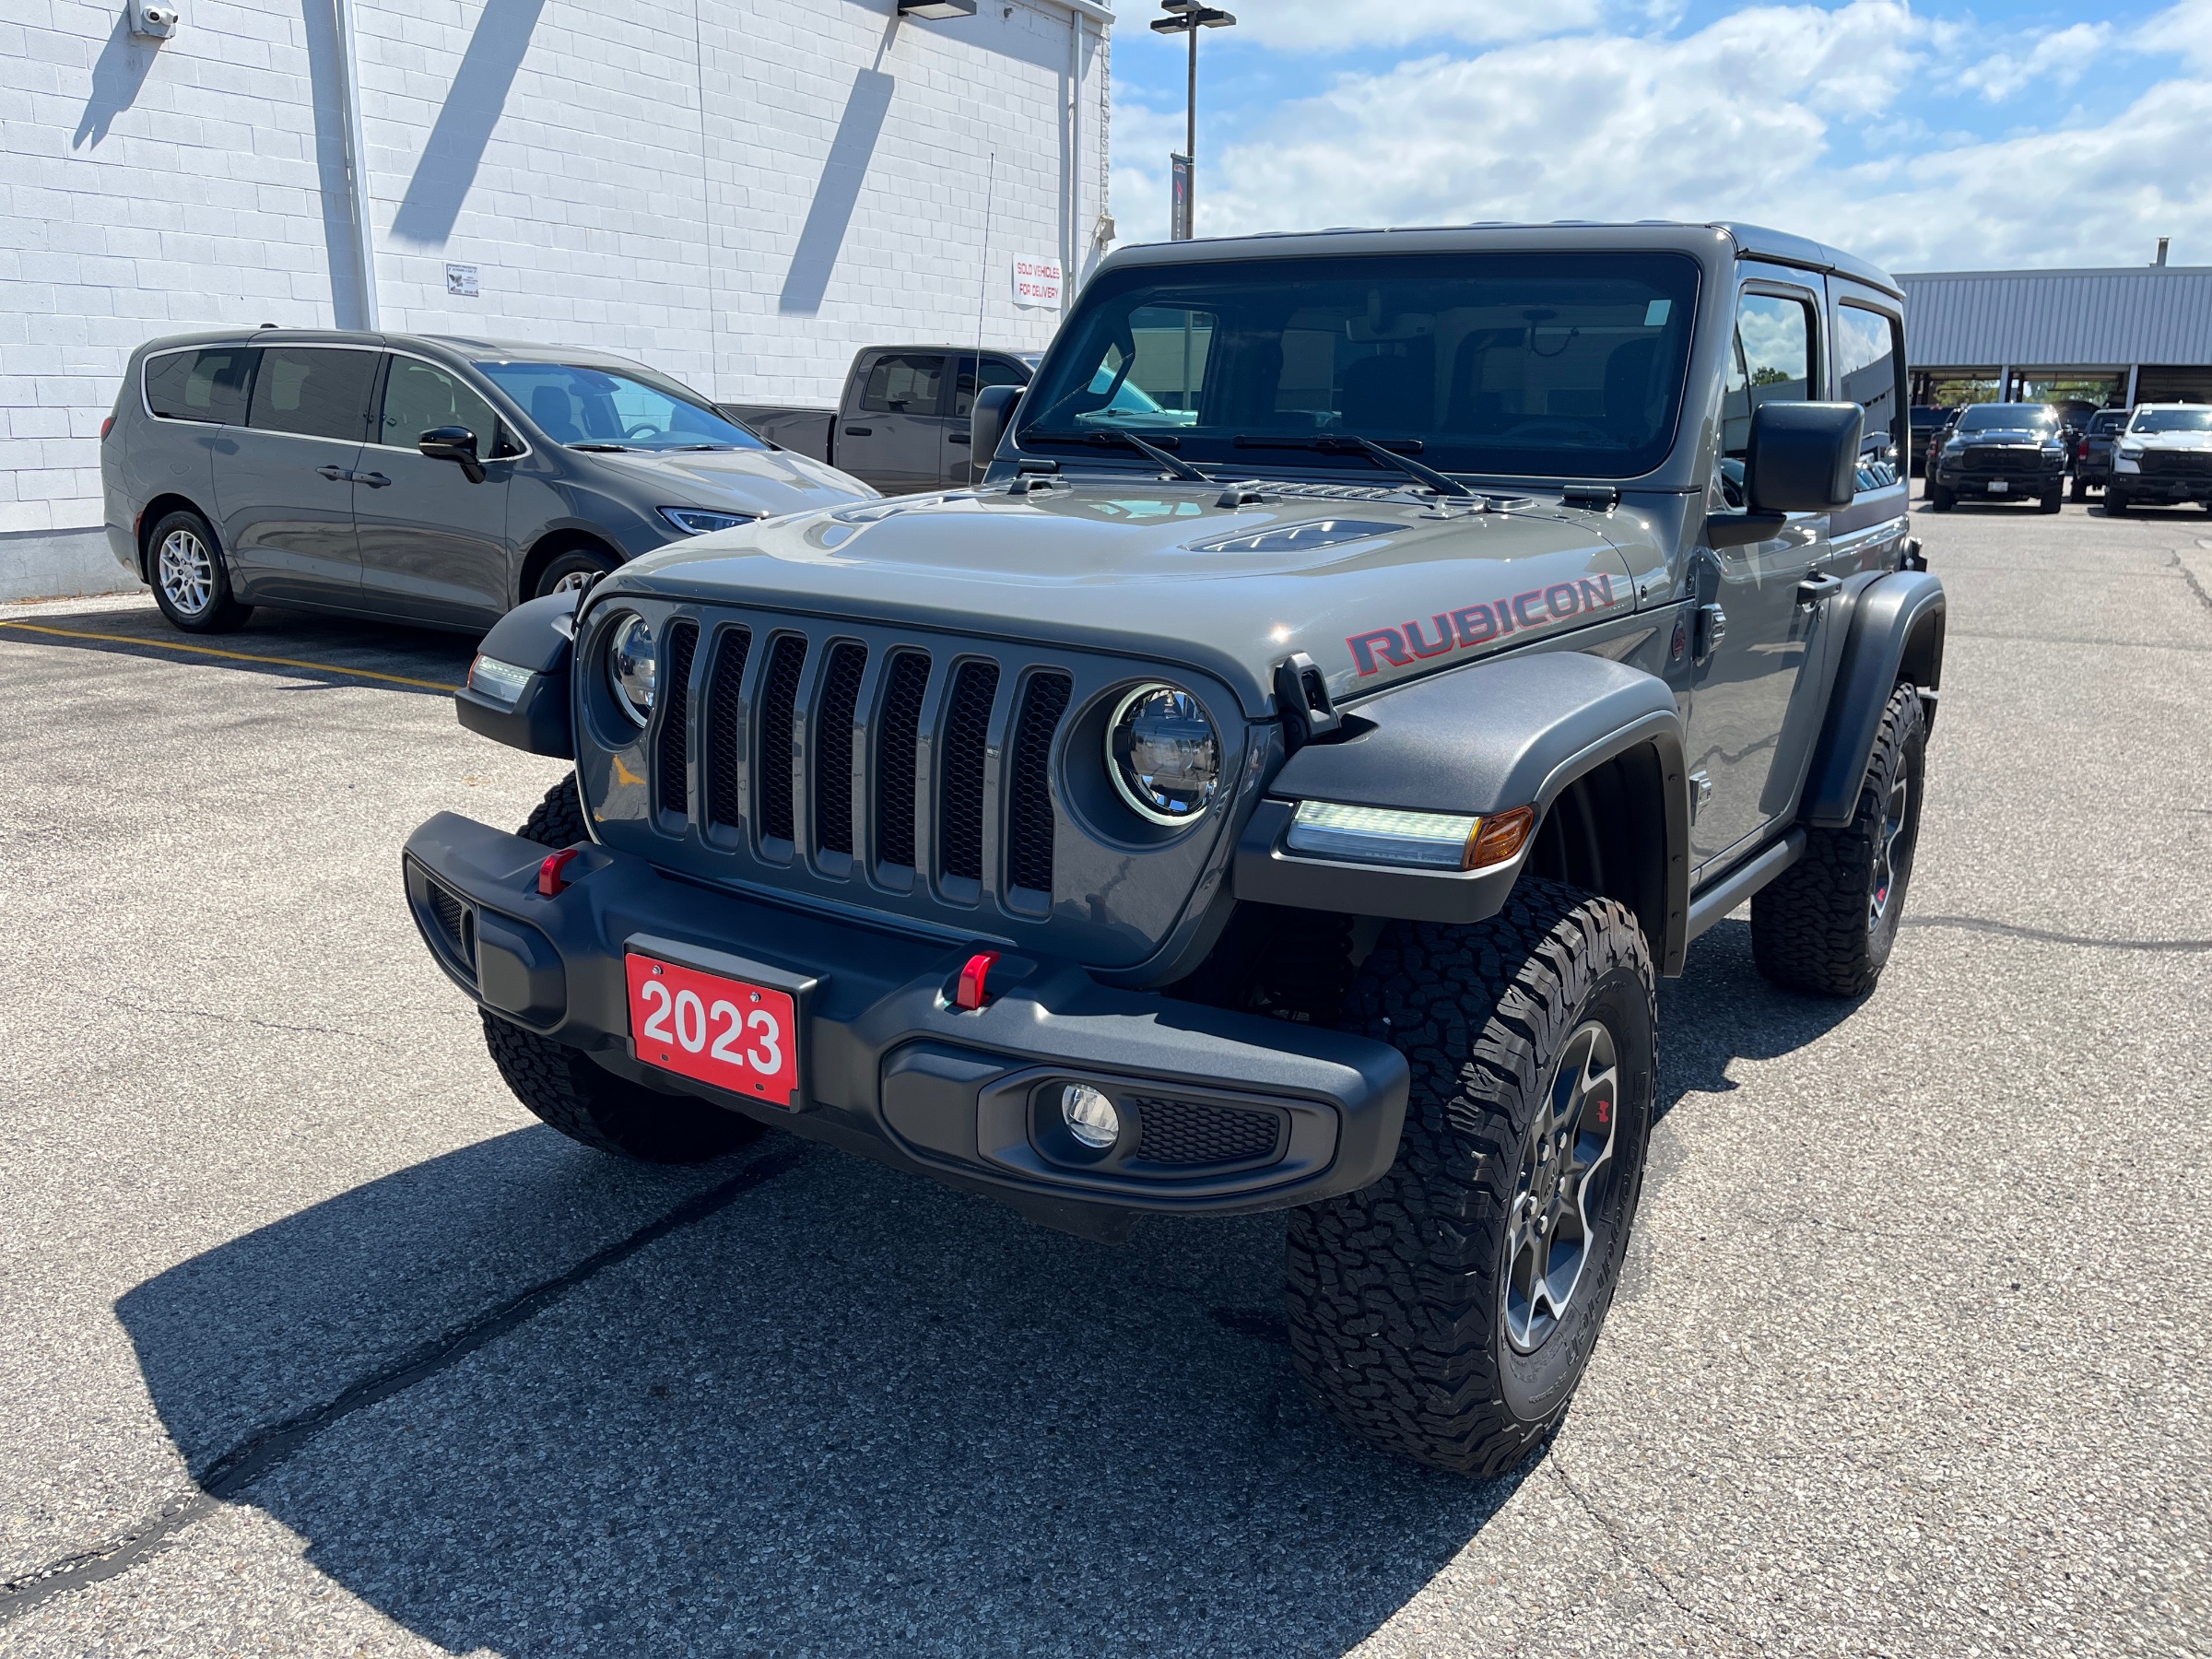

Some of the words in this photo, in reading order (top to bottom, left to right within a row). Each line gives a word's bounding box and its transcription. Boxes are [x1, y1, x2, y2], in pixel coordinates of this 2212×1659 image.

[1018, 262, 1032, 276] SOLD
[1033, 265, 1060, 279] VEHICLES
[1019, 283, 1030, 295] FOR
[1032, 285, 1059, 299] DELIVERY
[1346, 572, 1615, 677] RUBICON
[641, 980, 782, 1076] 2023
